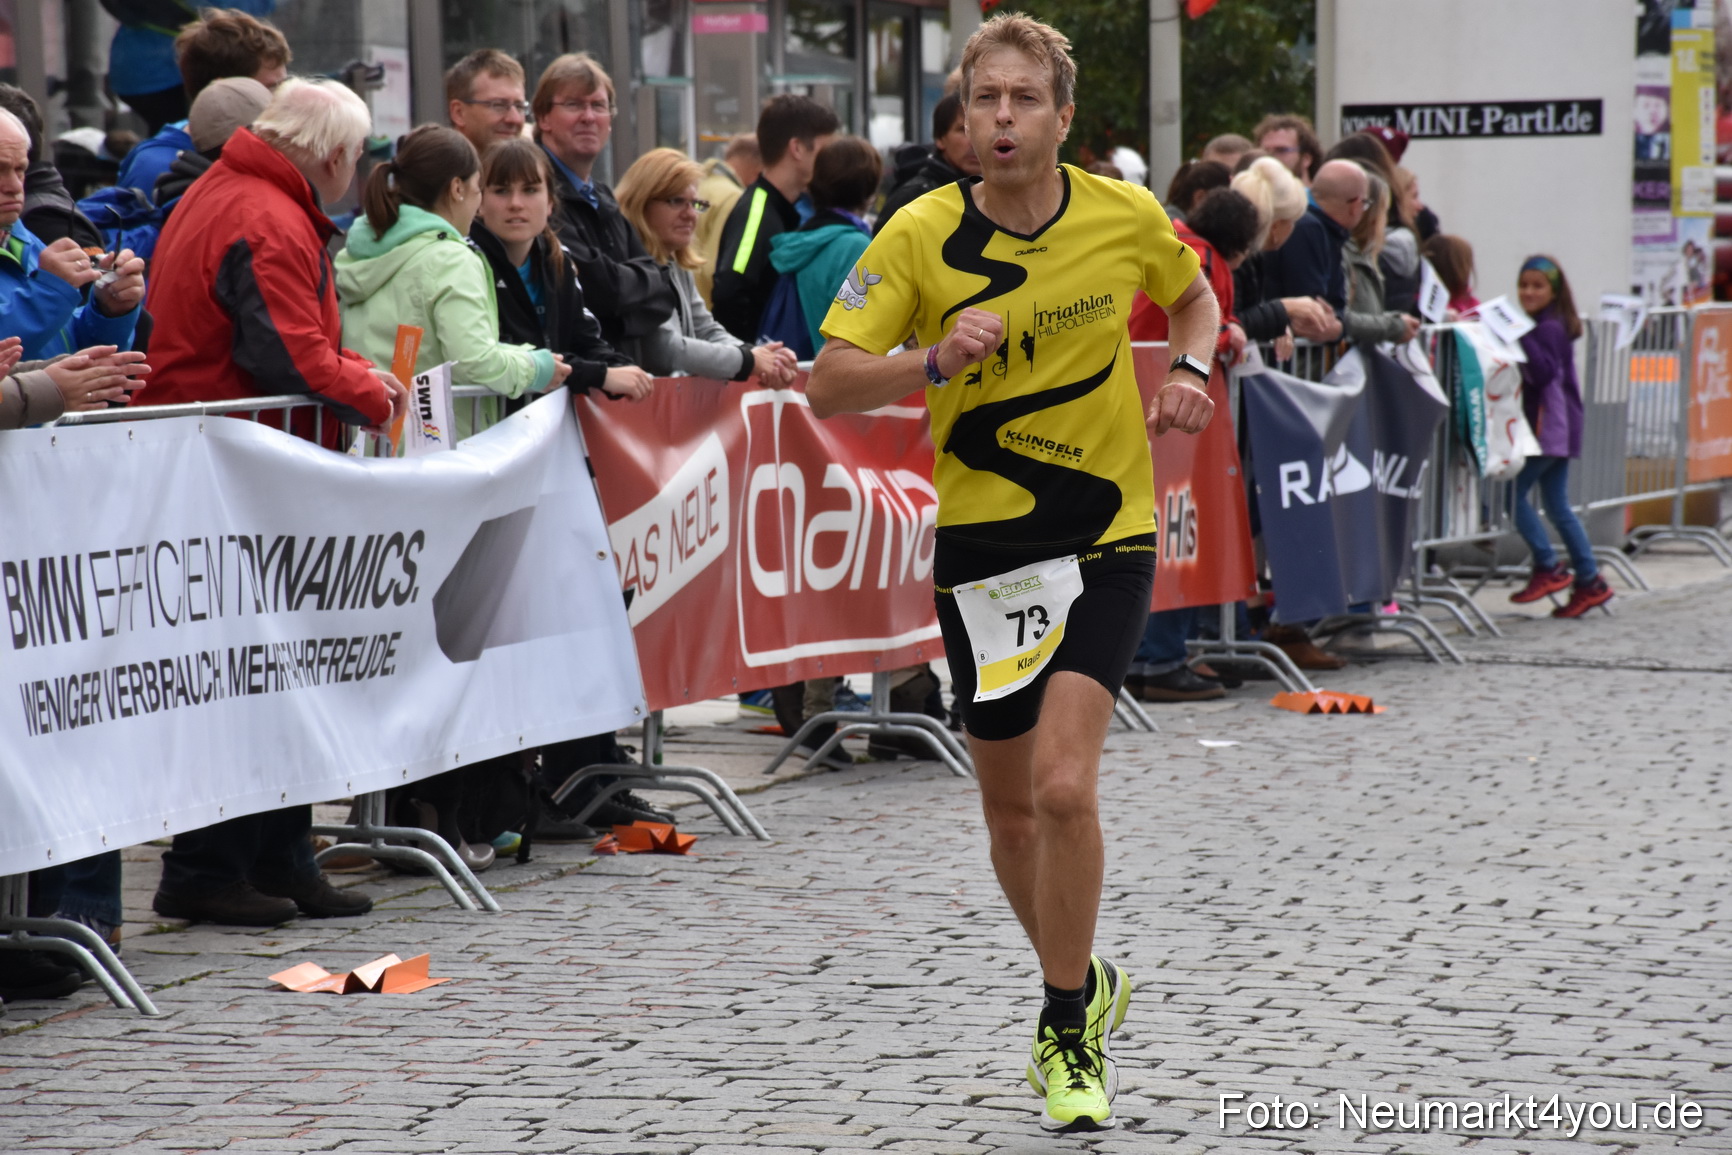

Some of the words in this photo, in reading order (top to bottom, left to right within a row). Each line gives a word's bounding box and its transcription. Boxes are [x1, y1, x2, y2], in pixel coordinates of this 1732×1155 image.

[1342, 104, 1594, 137] wwwMINI-Partl.de
[1034, 293, 1114, 328] Triathlon
[1037, 305, 1117, 339] HILPOLTSTEIN
[416, 374, 433, 421] swn
[1005, 429, 1084, 458] KLINGELE
[669, 466, 720, 574] NEUE
[1086, 551, 1103, 563] Day
[1, 553, 88, 650] BMW
[1005, 604, 1050, 647] 73
[980, 653, 986, 661] B
[1017, 650, 1041, 672] Klaus
[19, 670, 103, 737] WENIGER
[104, 649, 225, 720] VERBRAUCH.
